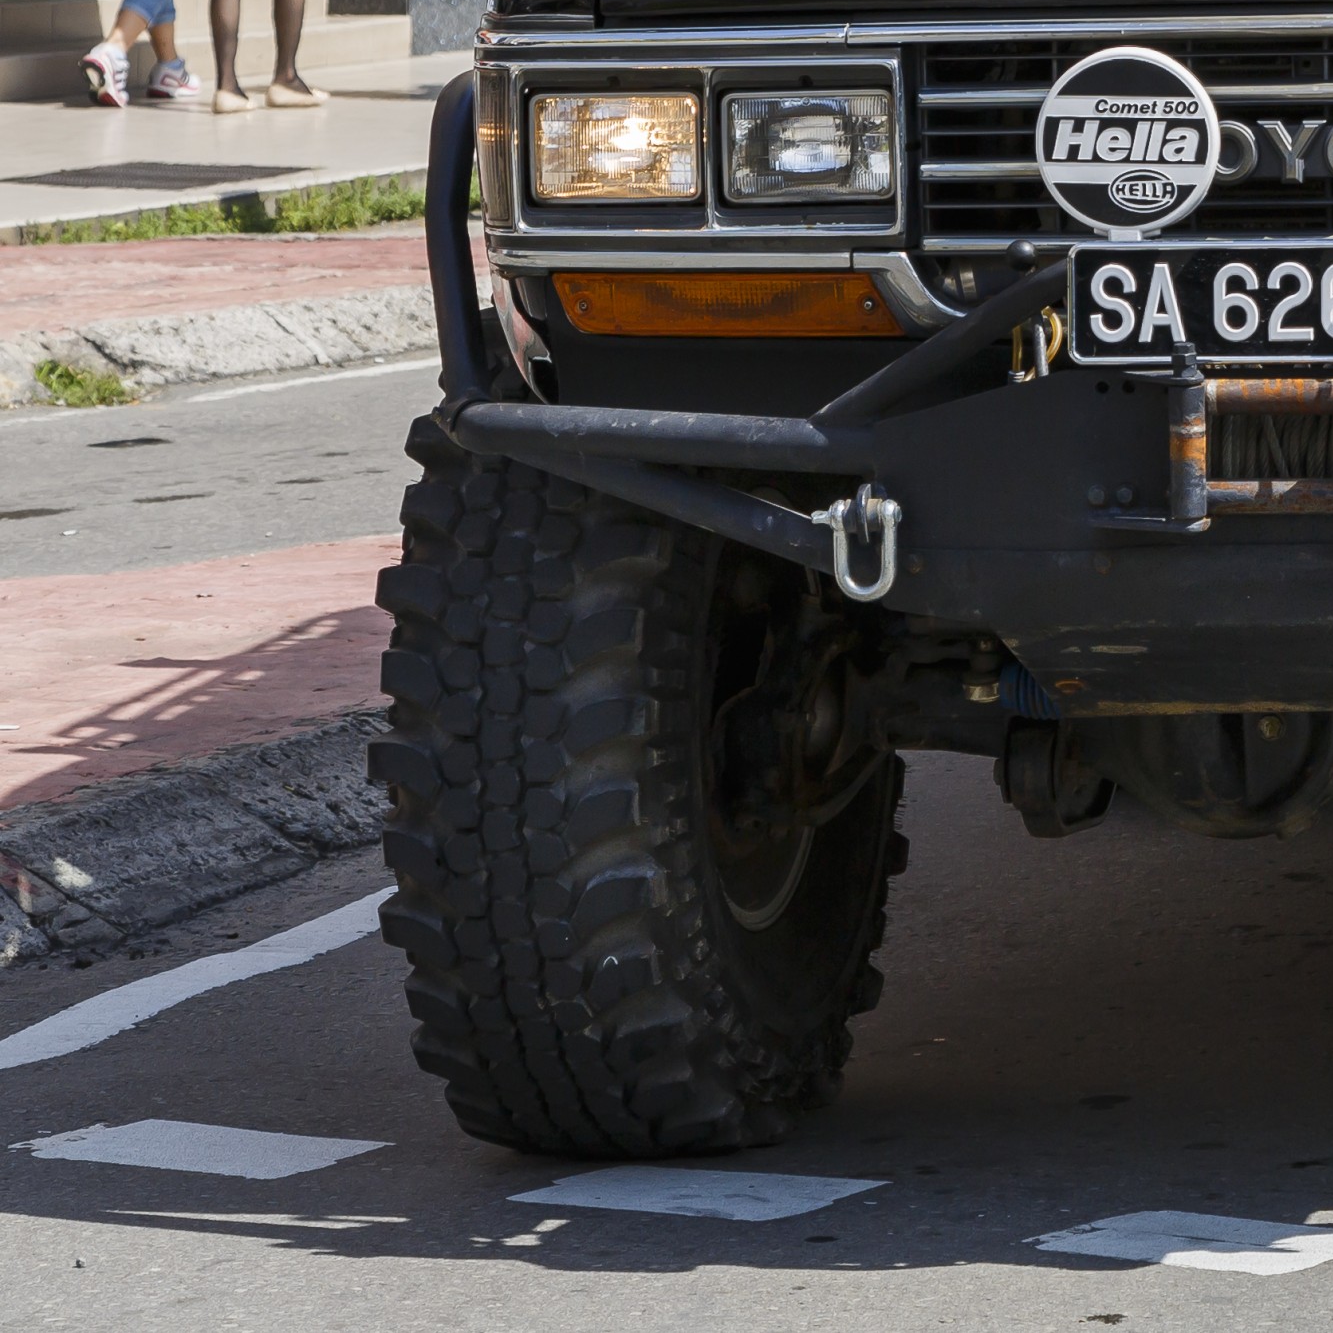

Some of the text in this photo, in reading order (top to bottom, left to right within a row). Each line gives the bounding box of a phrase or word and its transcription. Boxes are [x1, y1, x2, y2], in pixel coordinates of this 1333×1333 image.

[1095, 98, 1199, 115] Comet 500
[1052, 120, 1199, 162] Hella
[1115, 182, 1176, 200] HELLA
[1089, 263, 1186, 343] SA
